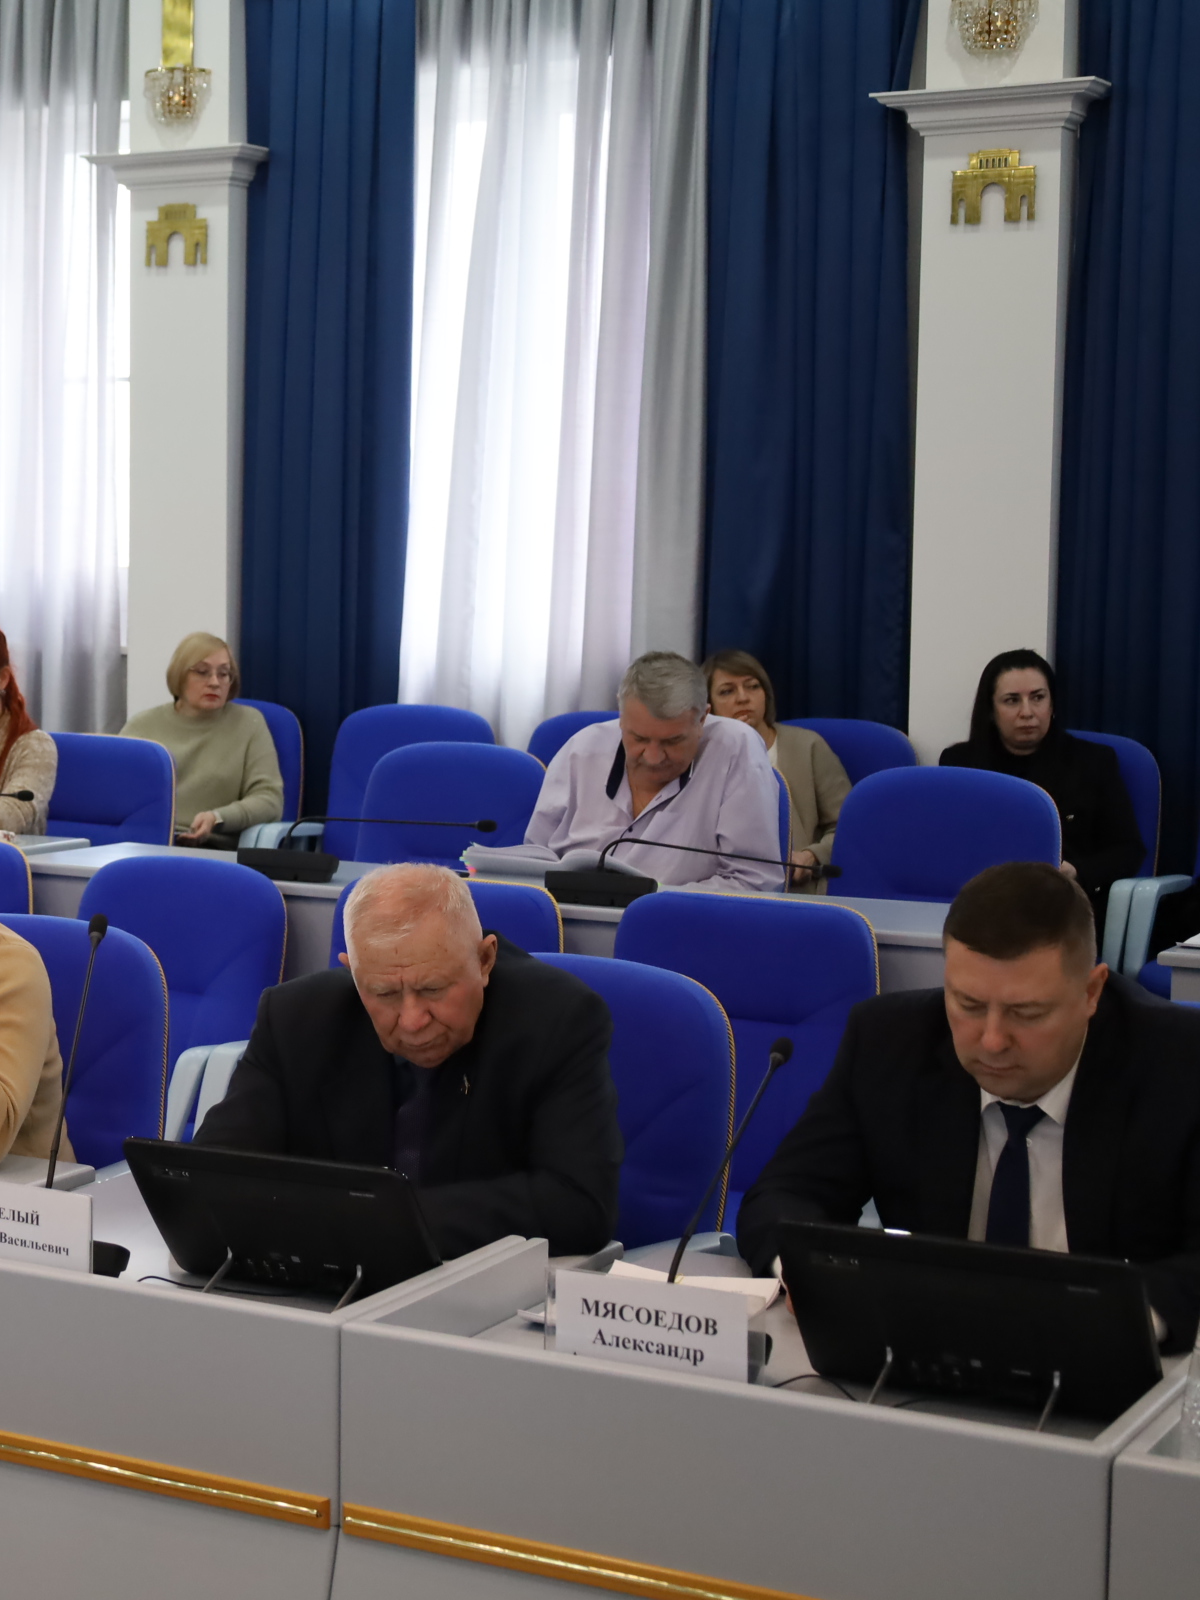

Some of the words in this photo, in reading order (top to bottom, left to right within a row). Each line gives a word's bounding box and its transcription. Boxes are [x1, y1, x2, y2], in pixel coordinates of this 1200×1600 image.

[0, 1231, 70, 1257] Васильевич
[580, 1297, 719, 1337] МЯСОЕДОВ
[591, 1328, 706, 1367] Александр
